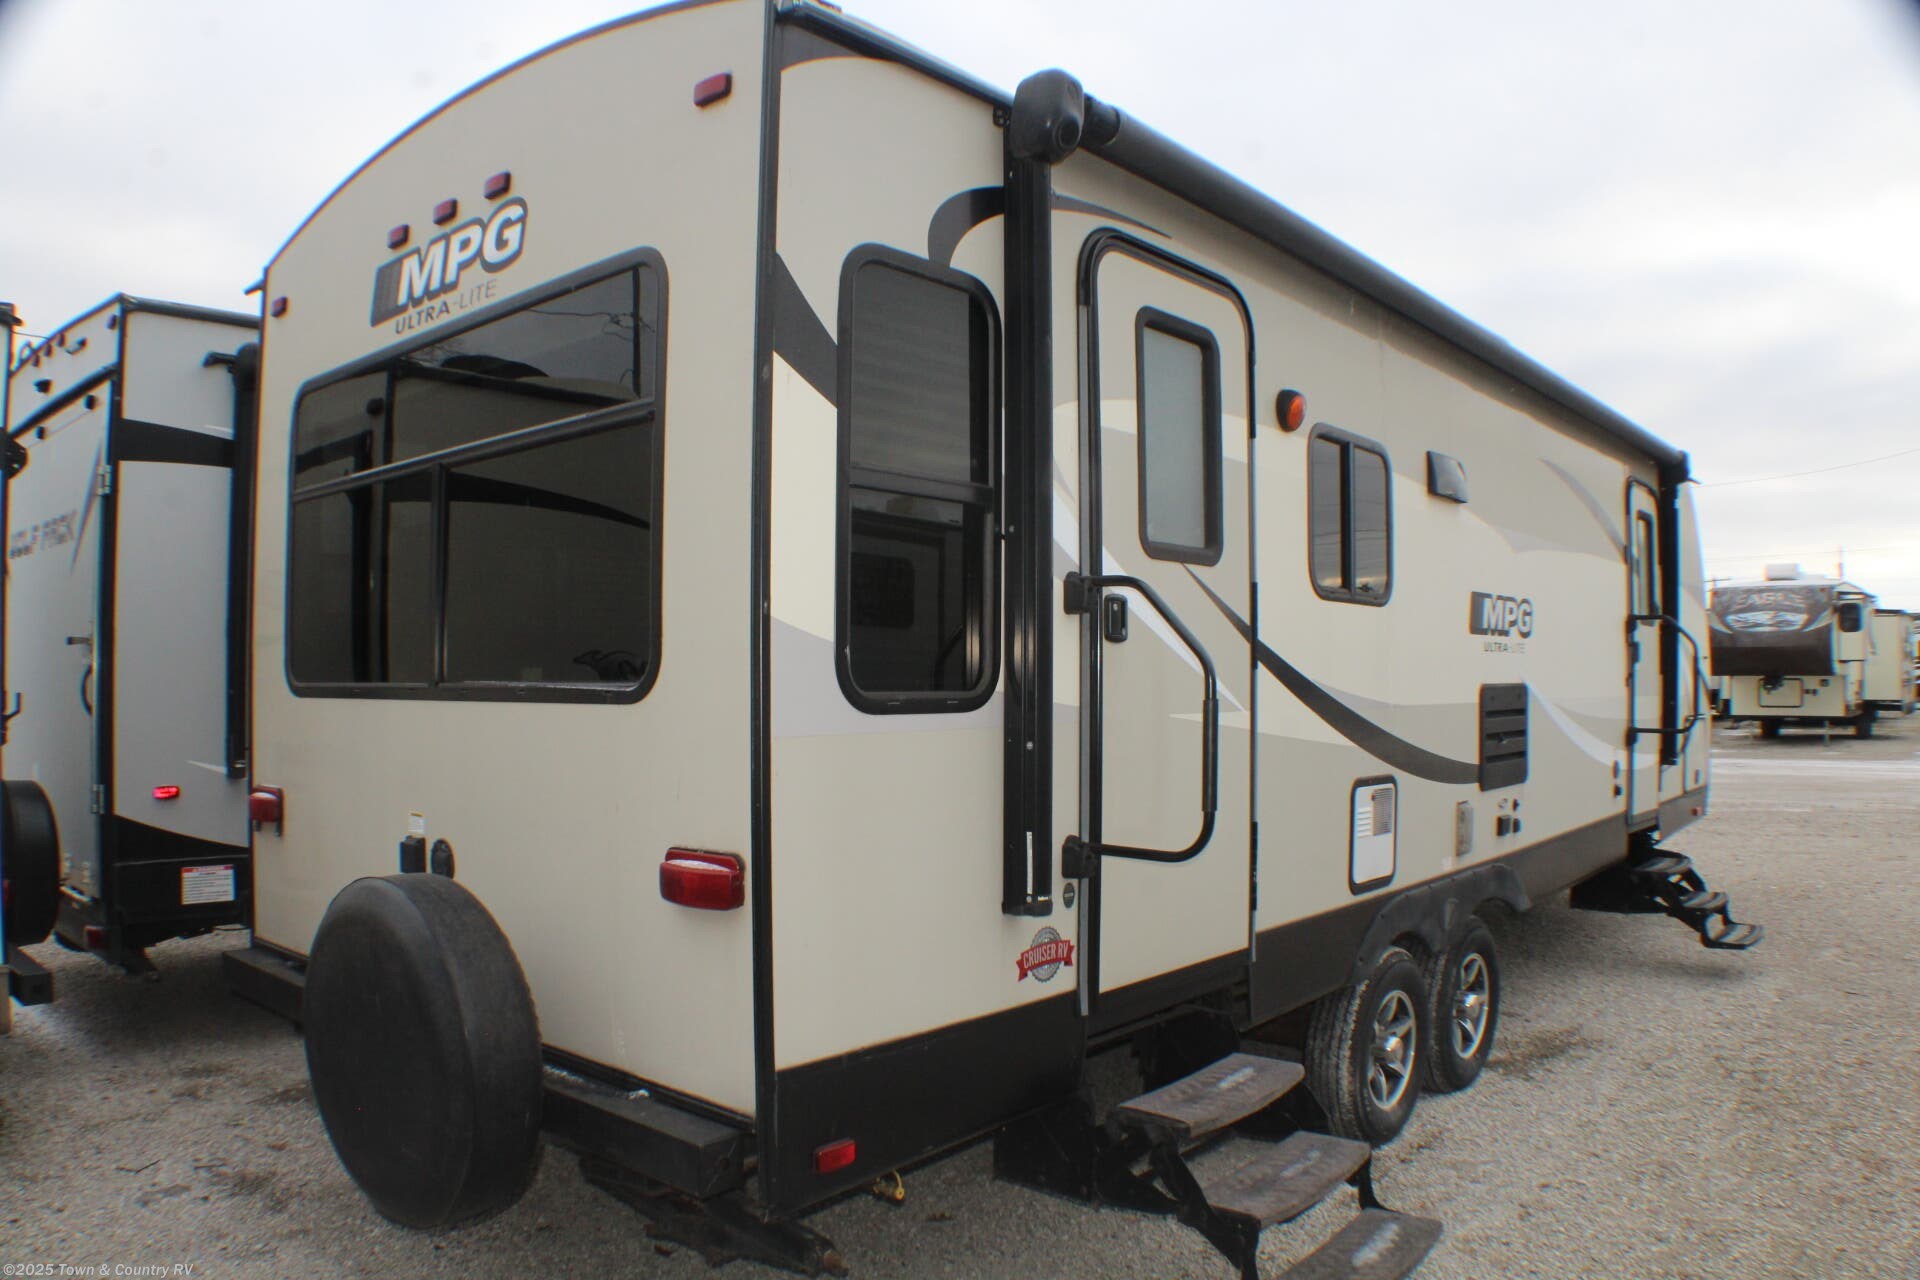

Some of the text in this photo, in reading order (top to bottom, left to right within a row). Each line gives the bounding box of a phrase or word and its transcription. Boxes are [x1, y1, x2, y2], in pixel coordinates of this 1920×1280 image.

[396, 197, 528, 309] MPG
[394, 279, 498, 334] ULTRA-LITE
[1481, 595, 1533, 639] MPG
[1023, 942, 1069, 969] CRUISER RV
